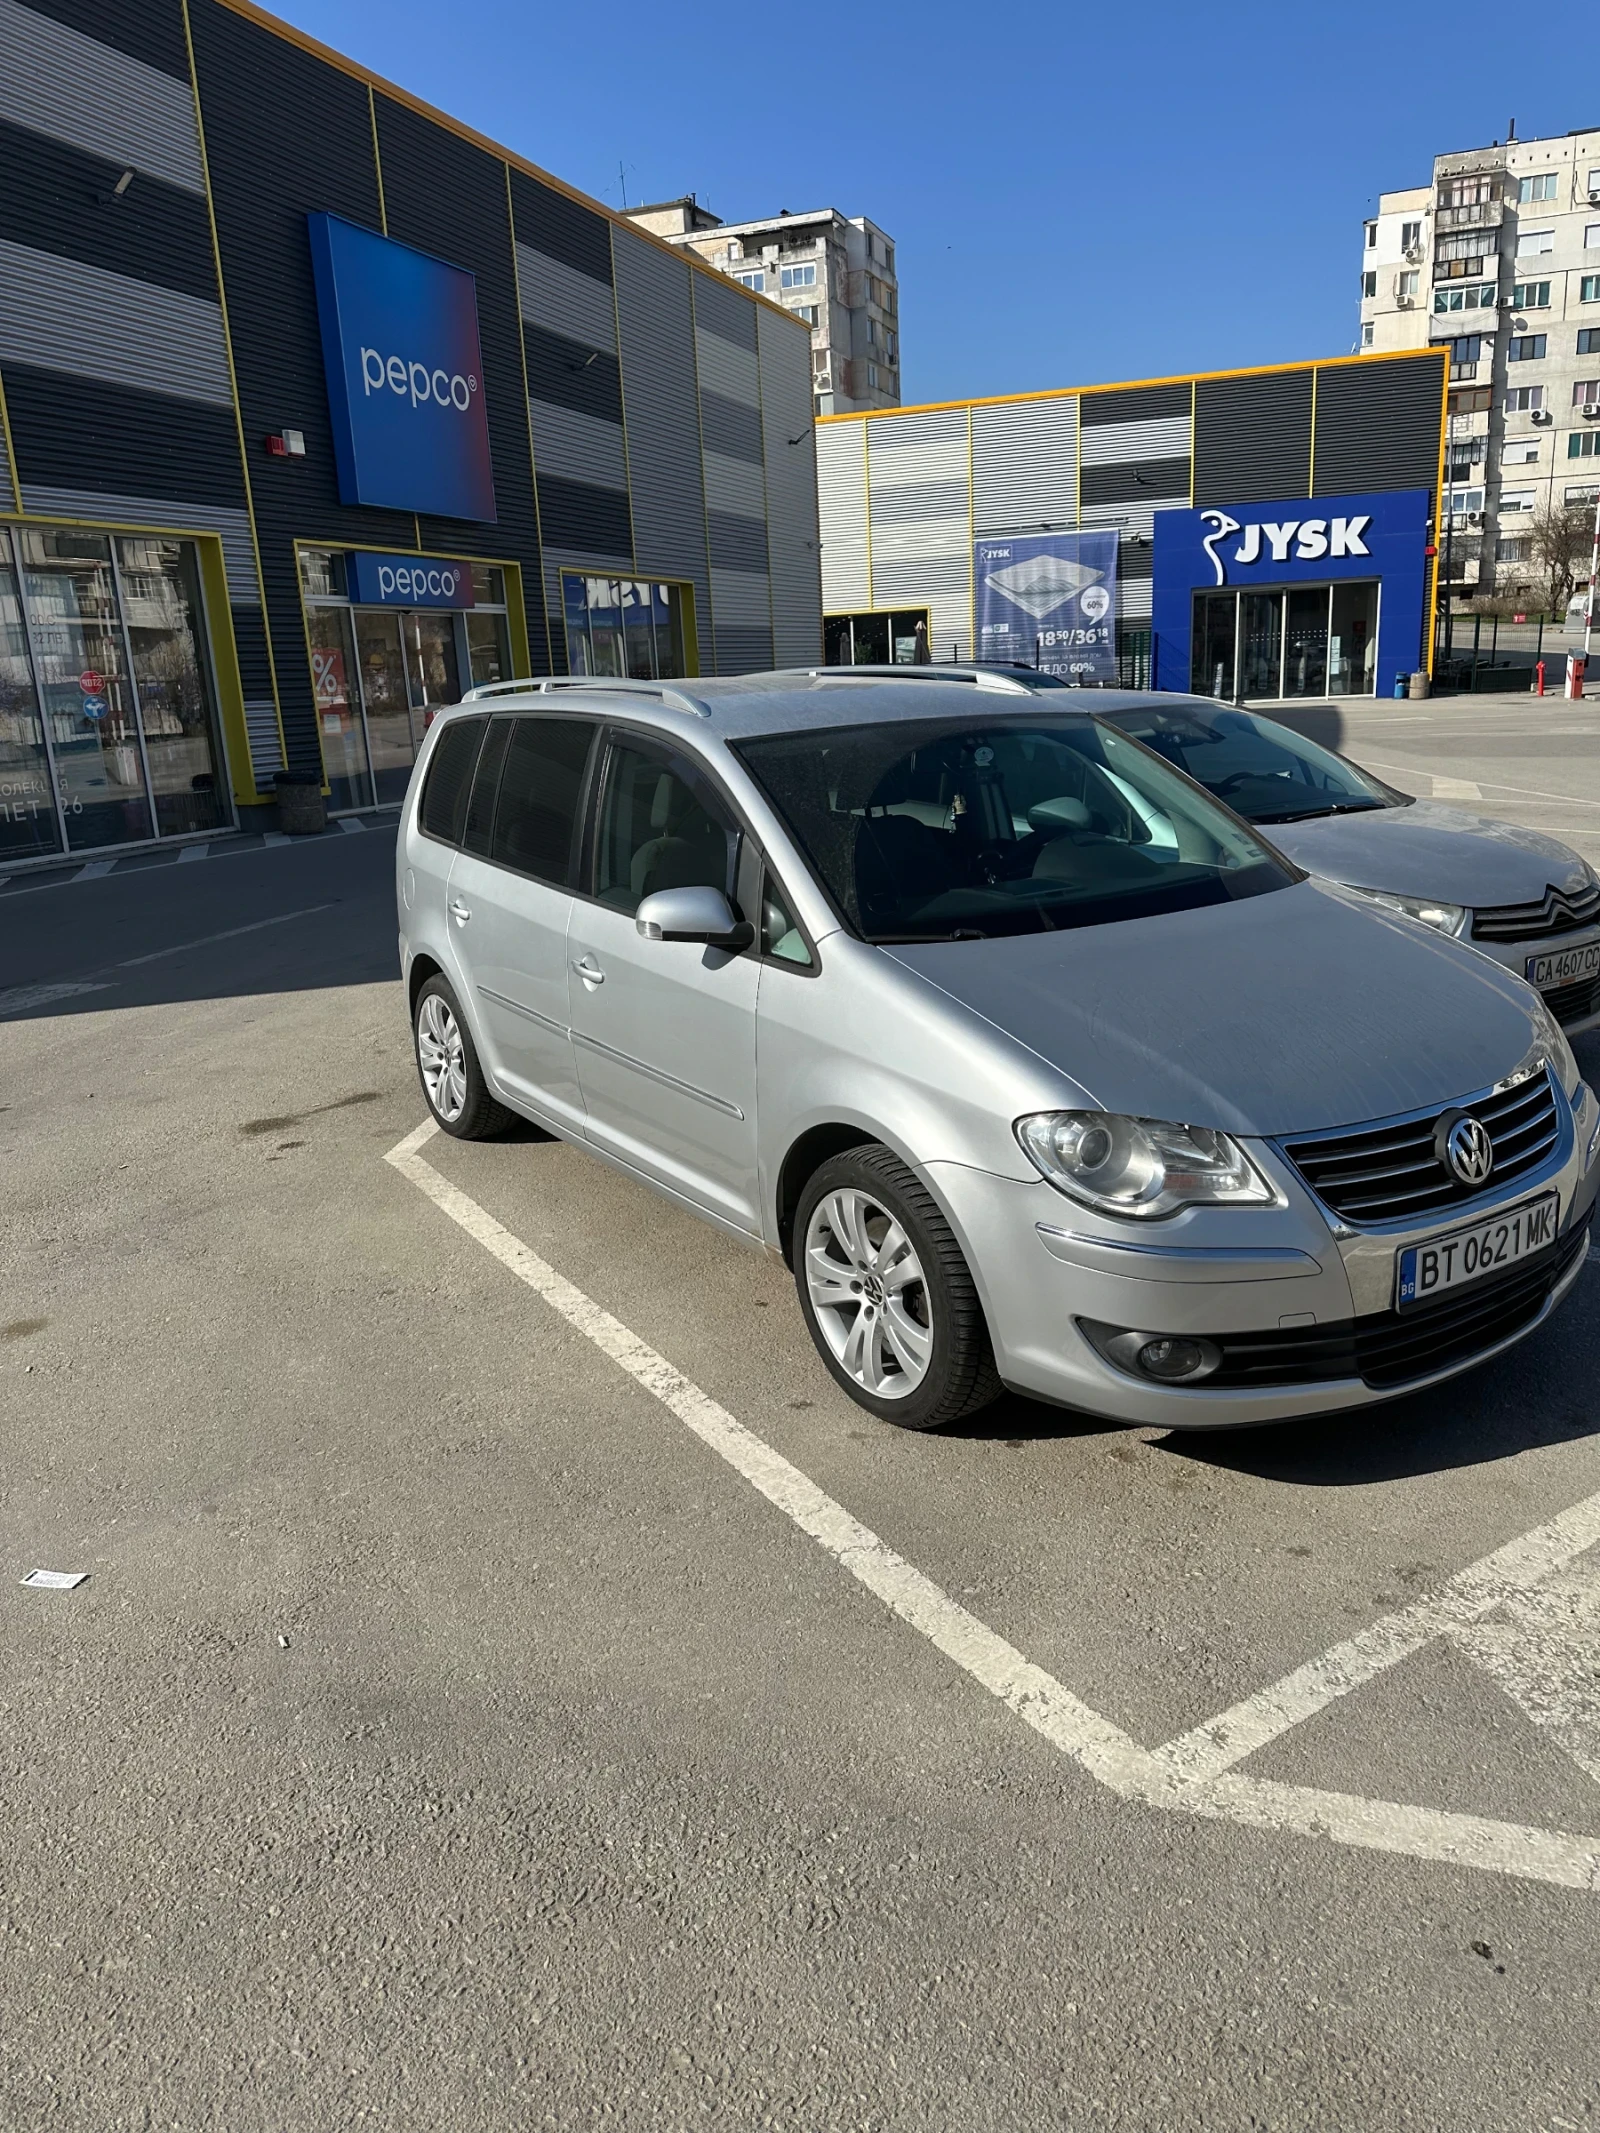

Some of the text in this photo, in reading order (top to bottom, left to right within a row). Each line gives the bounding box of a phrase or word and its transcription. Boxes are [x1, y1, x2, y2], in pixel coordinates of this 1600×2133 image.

[360, 346, 470, 411] pepco
[987, 548, 1010, 559] JYSK
[1234, 515, 1371, 563] JYSK
[378, 566, 456, 601] pepco
[1070, 662, 1095, 673] 60%
[1536, 959, 1553, 983] CA
[1555, 950, 1585, 978] 4607
[1421, 1202, 1553, 1291] BT 0621 MK
[1401, 1282, 1415, 1296] BG
